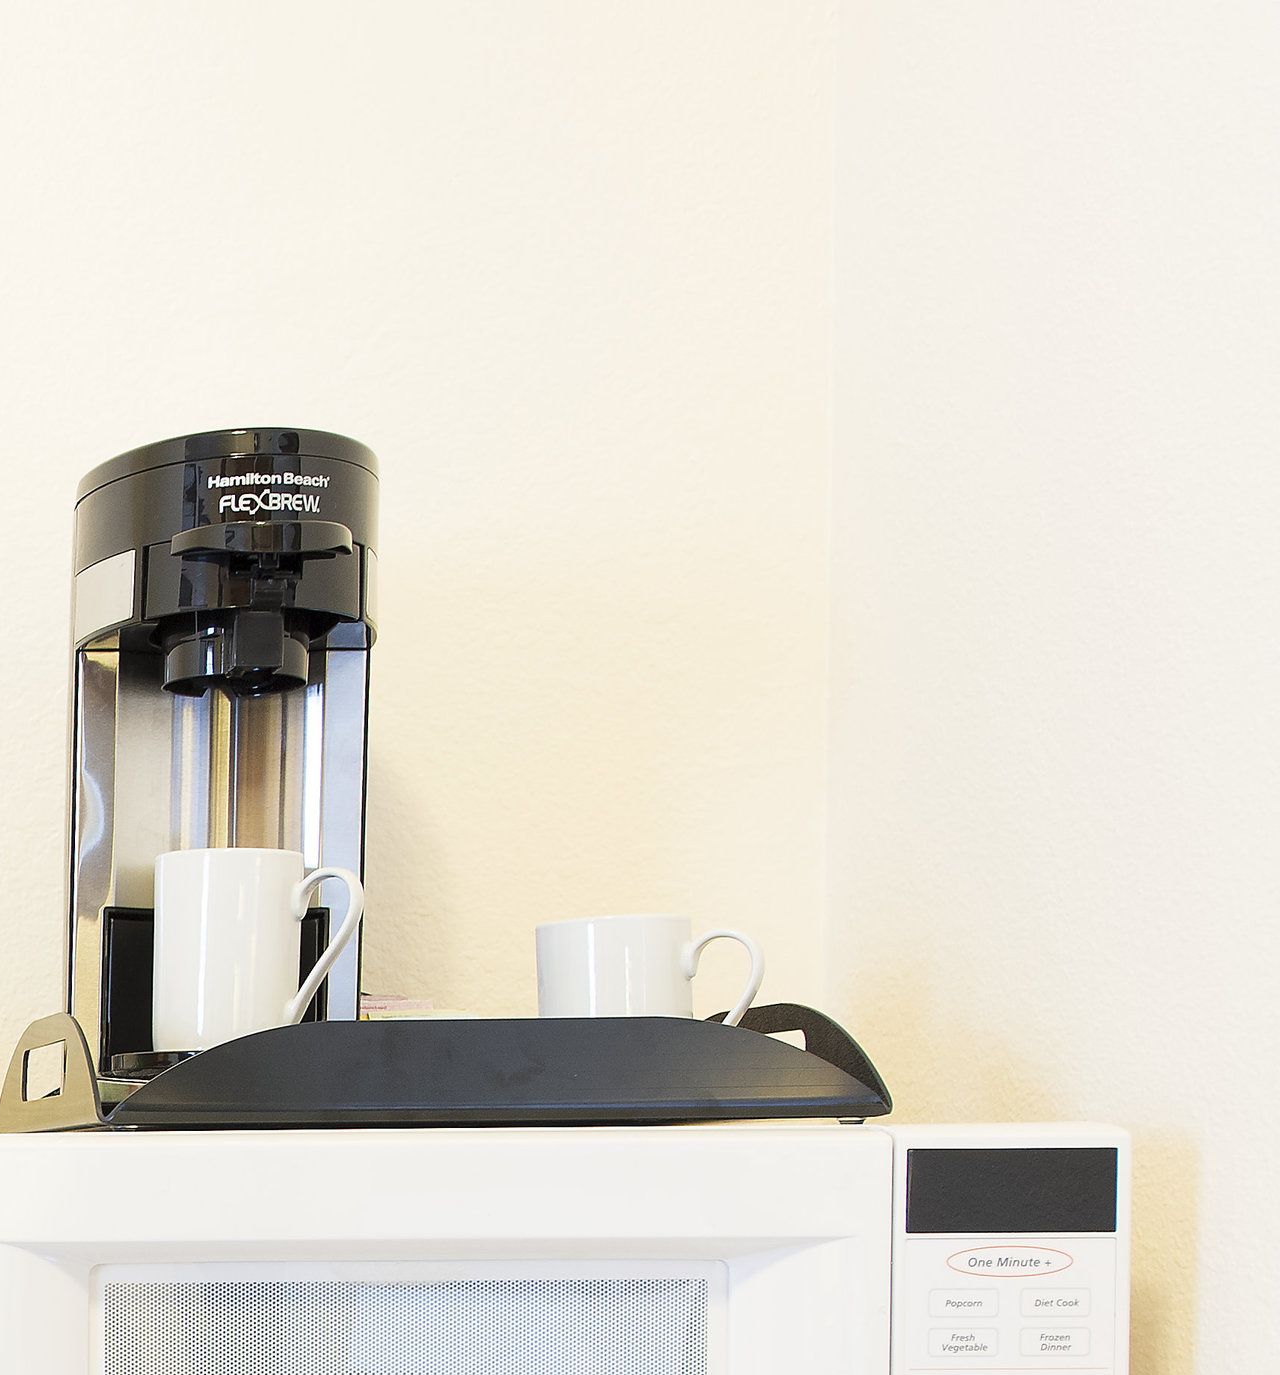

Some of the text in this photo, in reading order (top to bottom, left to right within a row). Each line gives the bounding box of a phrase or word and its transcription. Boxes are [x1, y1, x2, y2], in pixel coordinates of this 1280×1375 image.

[207, 473, 283, 489] Hamilton
[967, 1257, 993, 1268] One
[996, 1257, 1041, 1268] Minute
[945, 1299, 983, 1308] Popcorn
[1034, 1299, 1080, 1307] Diet Cook
[951, 1333, 975, 1342] Fresh
[1040, 1333, 1071, 1342] Frozen
[941, 1343, 988, 1353] Vegetable
[1040, 1343, 1072, 1351] Dinner
